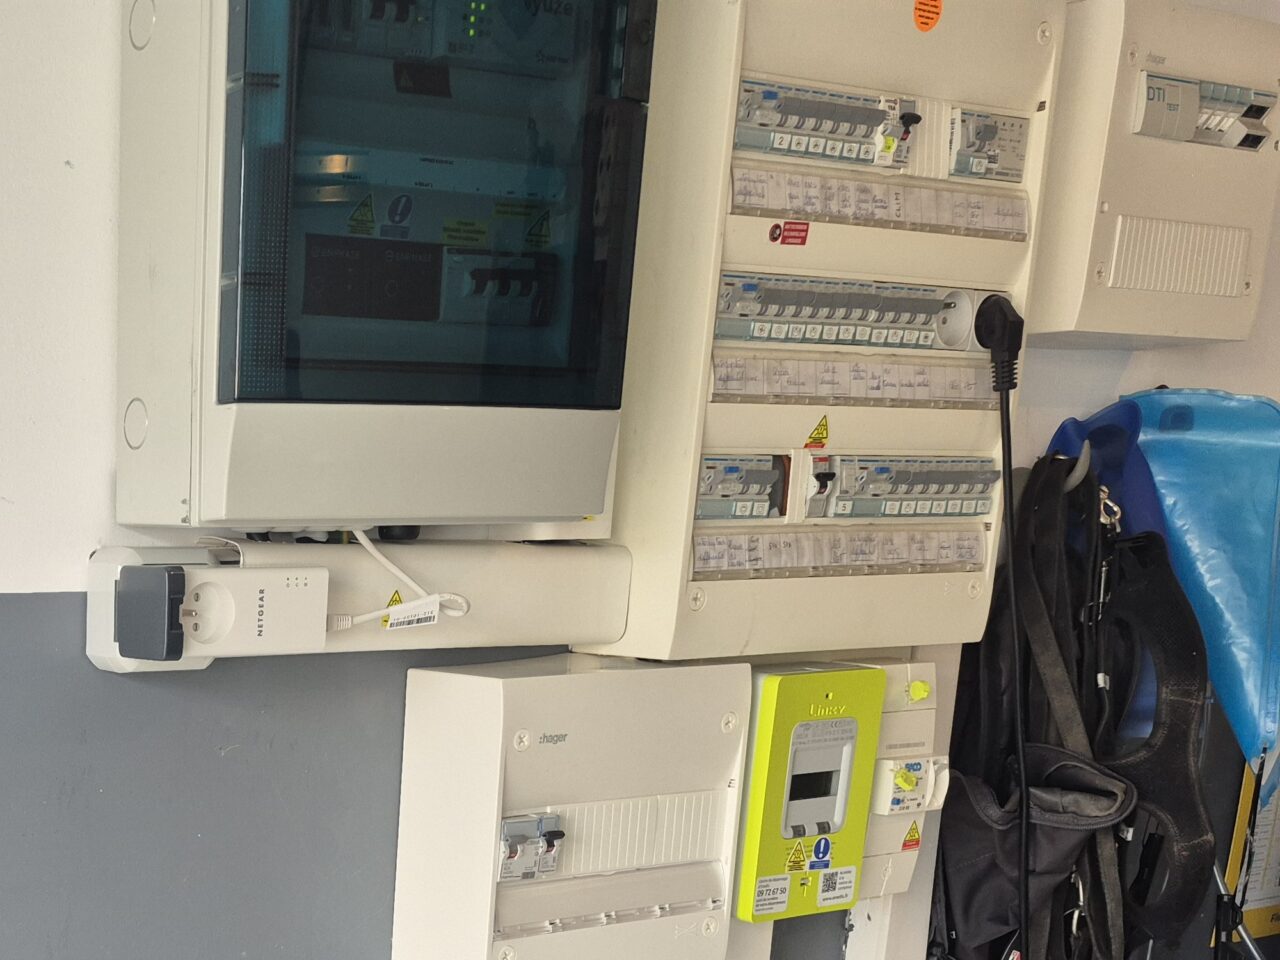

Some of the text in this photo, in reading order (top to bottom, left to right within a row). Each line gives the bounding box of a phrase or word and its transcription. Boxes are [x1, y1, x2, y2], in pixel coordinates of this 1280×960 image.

[1147, 86, 1165, 102] DTI
[778, 135, 785, 146] 2
[894, 192, 902, 218] CLIM
[257, 588, 266, 637] NETGEAR
[809, 703, 847, 717] Linky
